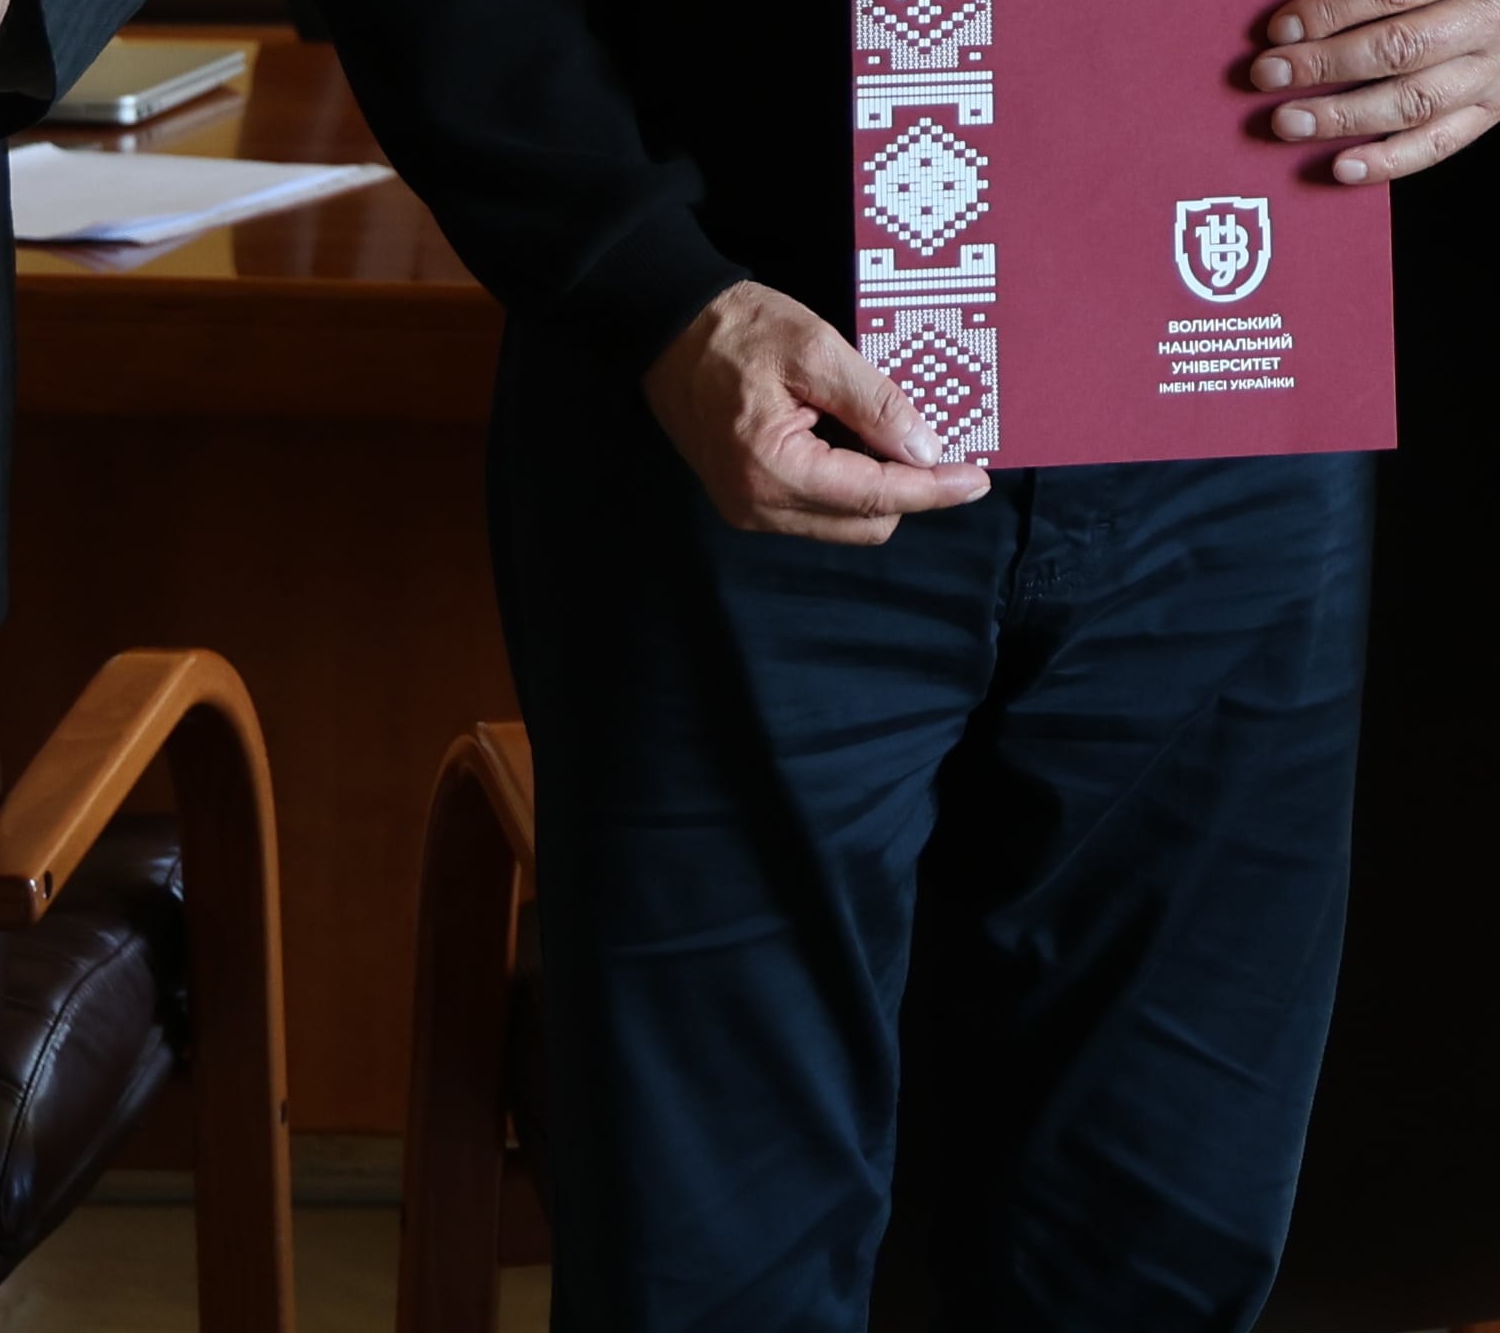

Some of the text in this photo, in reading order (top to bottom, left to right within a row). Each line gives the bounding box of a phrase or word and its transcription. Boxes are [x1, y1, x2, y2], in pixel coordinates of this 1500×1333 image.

[1168, 314, 1282, 333] ВОЛИНСЬКИЙ
[1158, 333, 1293, 355] НАЦІОНАЛЬНИЙ
[1171, 357, 1281, 374] УНІВЕРСИТЕТ
[1159, 376, 1294, 393] ІМЕНІ ЛЕСІ УКРАЇНКИ
